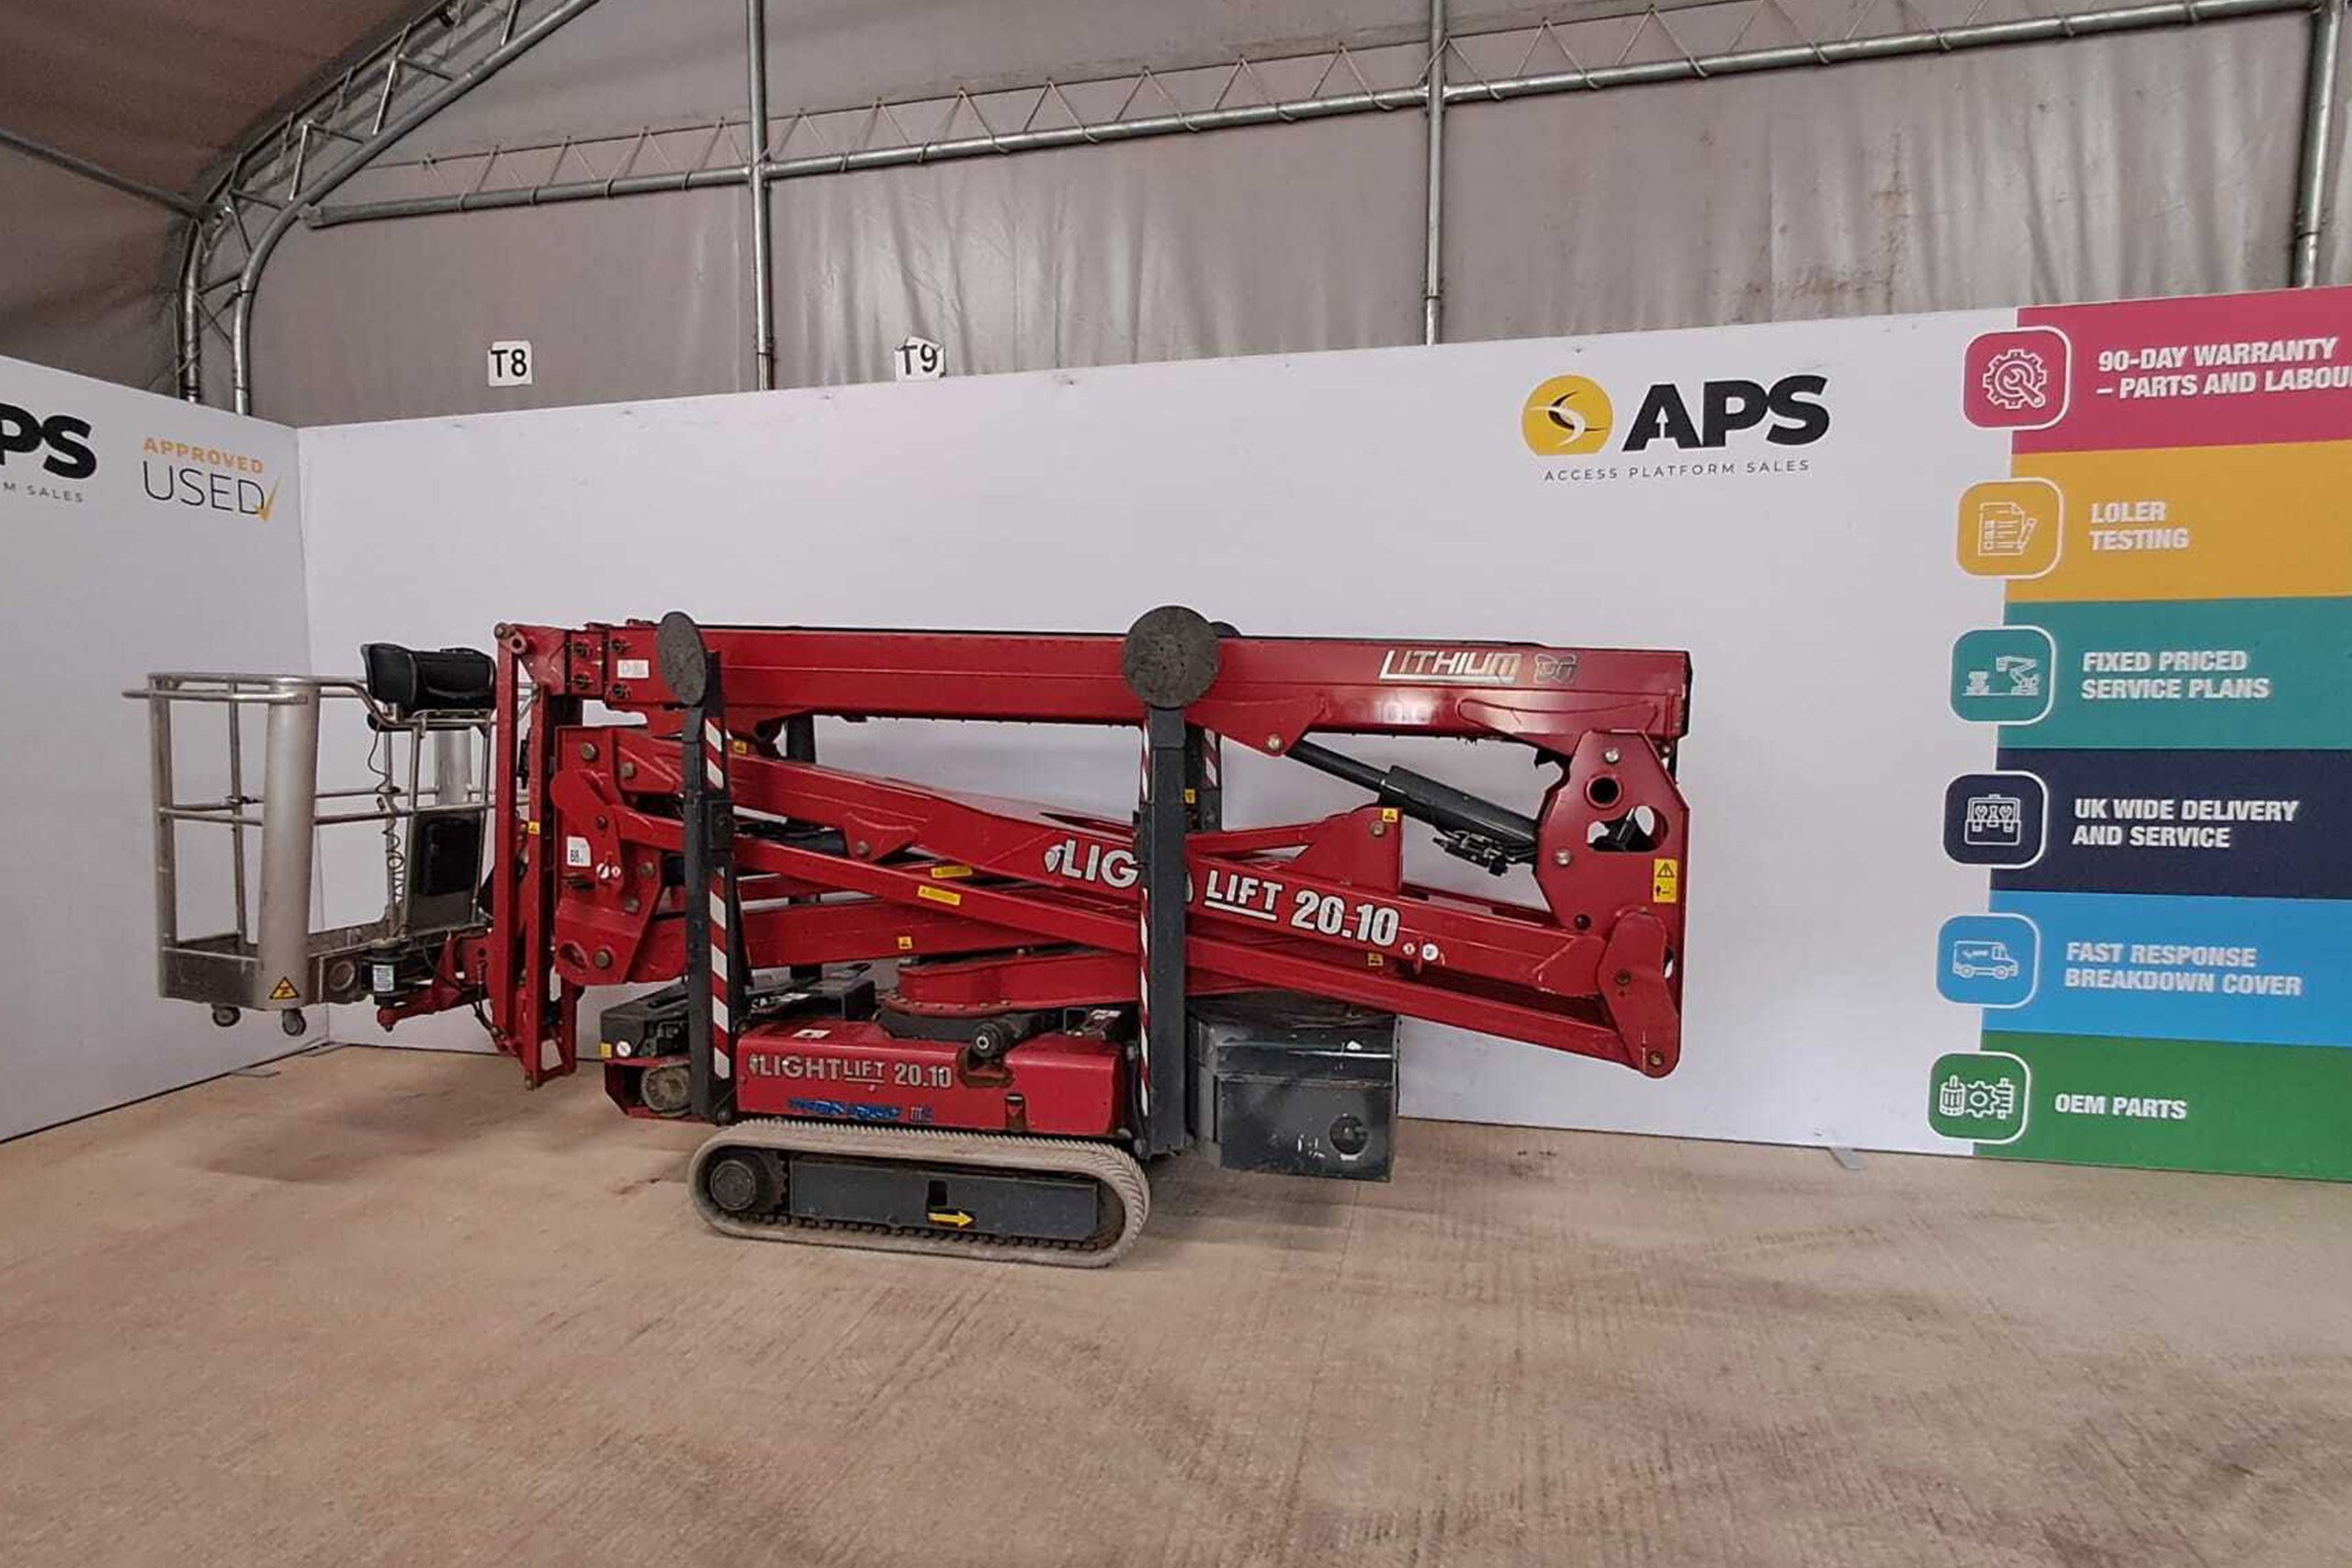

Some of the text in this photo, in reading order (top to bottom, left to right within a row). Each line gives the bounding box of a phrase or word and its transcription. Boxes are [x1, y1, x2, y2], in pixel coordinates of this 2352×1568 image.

[491, 348, 527, 378] T8
[899, 343, 939, 376] T9
[2098, 337, 2338, 372] 90-DAY WARRANTY
[2120, 374, 2198, 399] PARTS
[2204, 371, 2256, 395] AND
[2264, 365, 2352, 392] LABOU
[1622, 374, 1831, 452] APS
[0, 402, 96, 479] PS
[143, 436, 264, 474] APPROVED
[1544, 458, 1810, 482] ACCESS PLATFORM SALES
[28, 483, 84, 503] SALES
[142, 459, 266, 516] USED
[2091, 501, 2167, 524] LOLER
[2090, 527, 2190, 551] TESTING
[1379, 649, 1521, 681] LITHIUM
[2083, 649, 2248, 672] FIXED PRICED
[2081, 678, 2270, 699] SERVICE PLANS
[2075, 798, 2300, 823] UK WIDE DELIVERY
[2072, 825, 2233, 849] AND SERVICE
[1061, 839, 1140, 887] LIG
[1290, 889, 1400, 947] 20.10
[2066, 942, 2257, 967] FAST RESPONSE
[2064, 969, 2303, 996] BREAKDOWN COVER
[895, 1063, 953, 1088] 20.10
[2054, 1093, 2188, 1120] OEM PARTS
